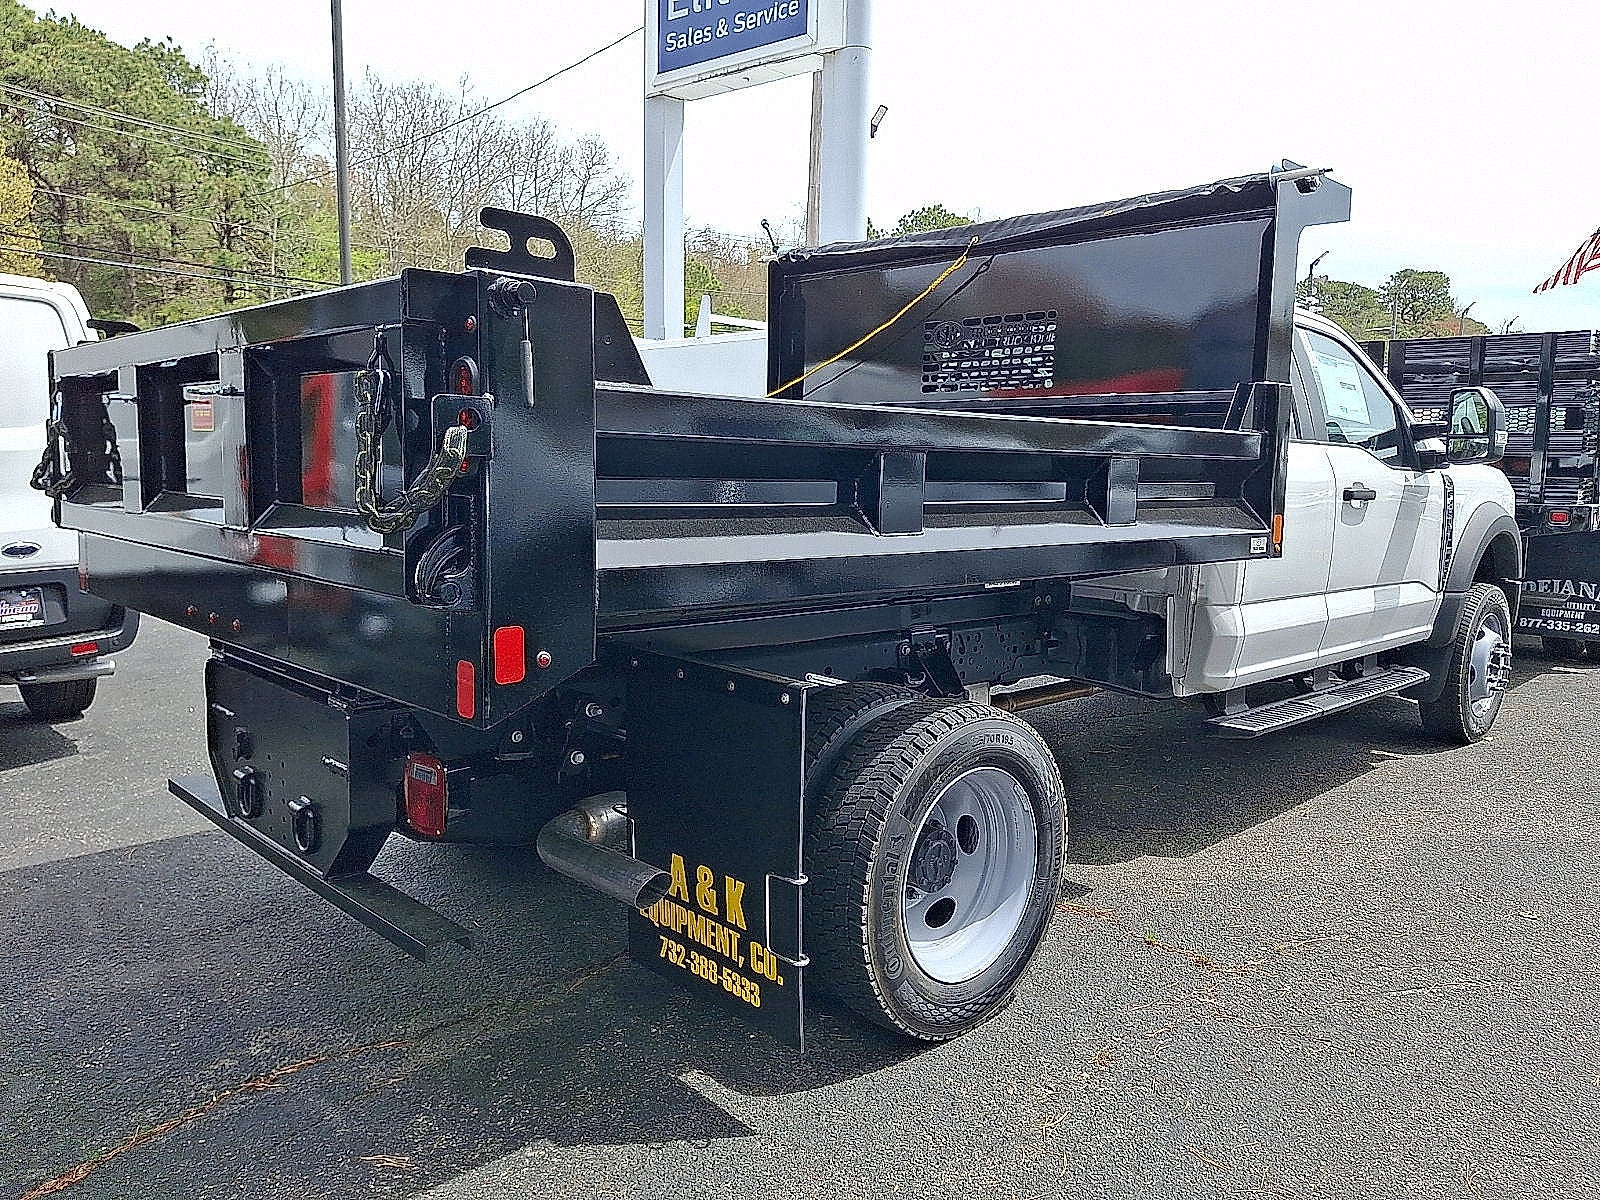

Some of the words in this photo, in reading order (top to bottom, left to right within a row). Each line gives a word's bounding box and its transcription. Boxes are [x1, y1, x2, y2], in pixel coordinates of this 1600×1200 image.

[665, 26, 712, 52] Sales
[715, 17, 730, 38] &
[732, 0, 800, 33] Service
[1519, 617, 1600, 635] 877-335-262
[1541, 608, 1586, 620] EQUIPMENT
[668, 852, 690, 903] A
[696, 864, 719, 916] &
[725, 875, 748, 931] K
[639, 898, 745, 969] QUIPMENT,
[658, 934, 762, 1008] 732-388-5333
